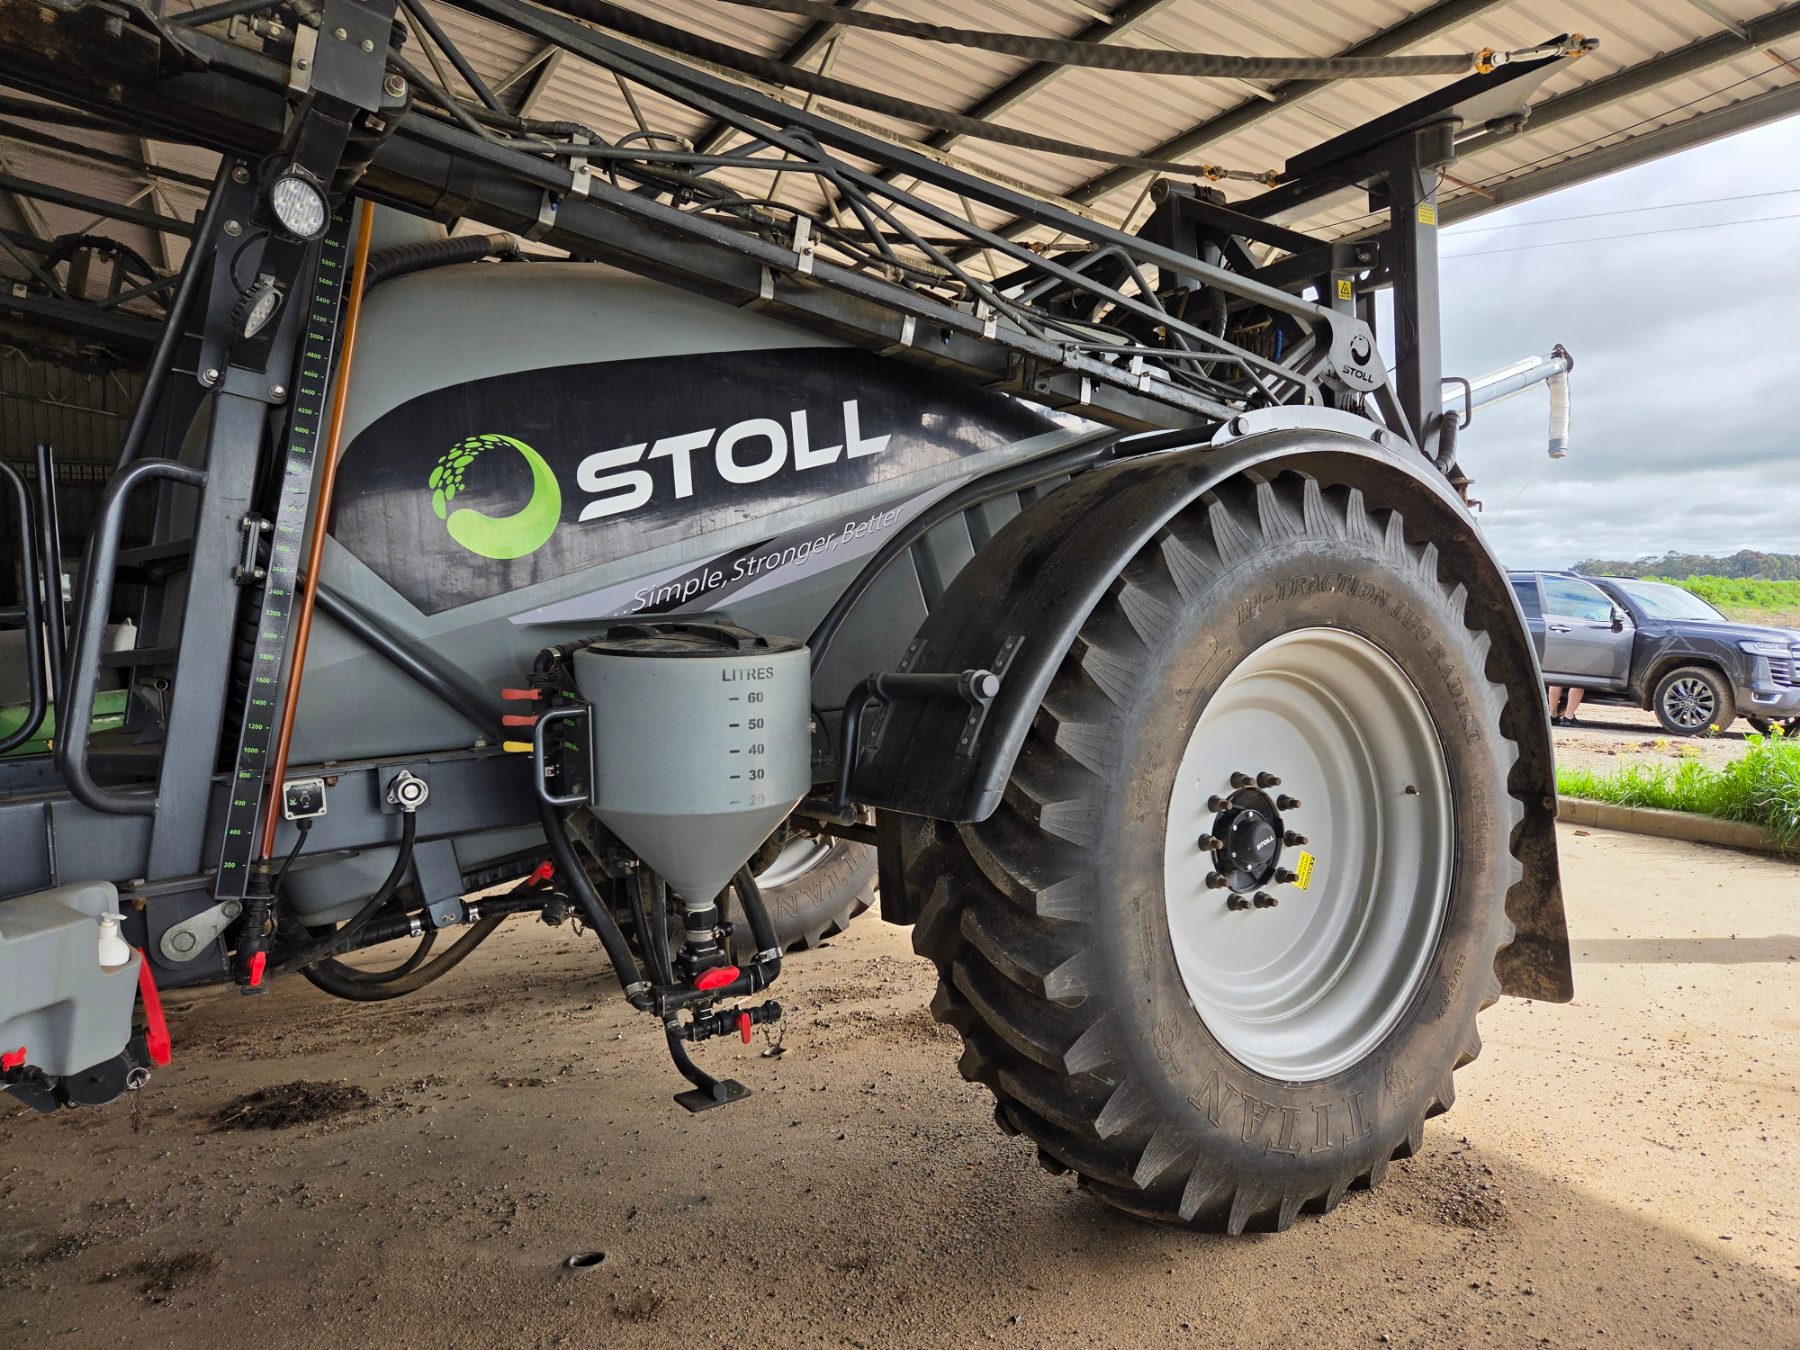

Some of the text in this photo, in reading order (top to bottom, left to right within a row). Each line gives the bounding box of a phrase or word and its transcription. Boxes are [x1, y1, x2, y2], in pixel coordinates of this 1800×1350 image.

[324, 238, 340, 249] 6000
[321, 258, 336, 269] 5800
[318, 277, 333, 287] 5600
[315, 295, 331, 305] 5400
[312, 314, 328, 324] 5200
[309, 332, 325, 341] 5000
[306, 351, 322, 360] 4800
[303, 370, 319, 379] 4600
[1342, 364, 1374, 384] STOLL
[300, 387, 316, 396] 4400
[298, 407, 313, 416] 4200
[294, 425, 310, 435] 4000
[291, 445, 306, 454] 3800
[576, 399, 892, 523] STOLL
[840, 505, 904, 545] Better
[268, 588, 285, 597] 2400
[265, 609, 281, 617] 2200
[260, 653, 275, 661] 1800
[721, 667, 775, 682] LITRES
[256, 676, 271, 684] 1600
[747, 692, 764, 703] 60
[748, 718, 765, 730] 50
[244, 746, 259, 754] 1000
[748, 744, 765, 755] 40
[748, 769, 765, 781] 30
[1256, 835, 1275, 851] STOLL
[1187, 1067, 1374, 1160] TITAN
